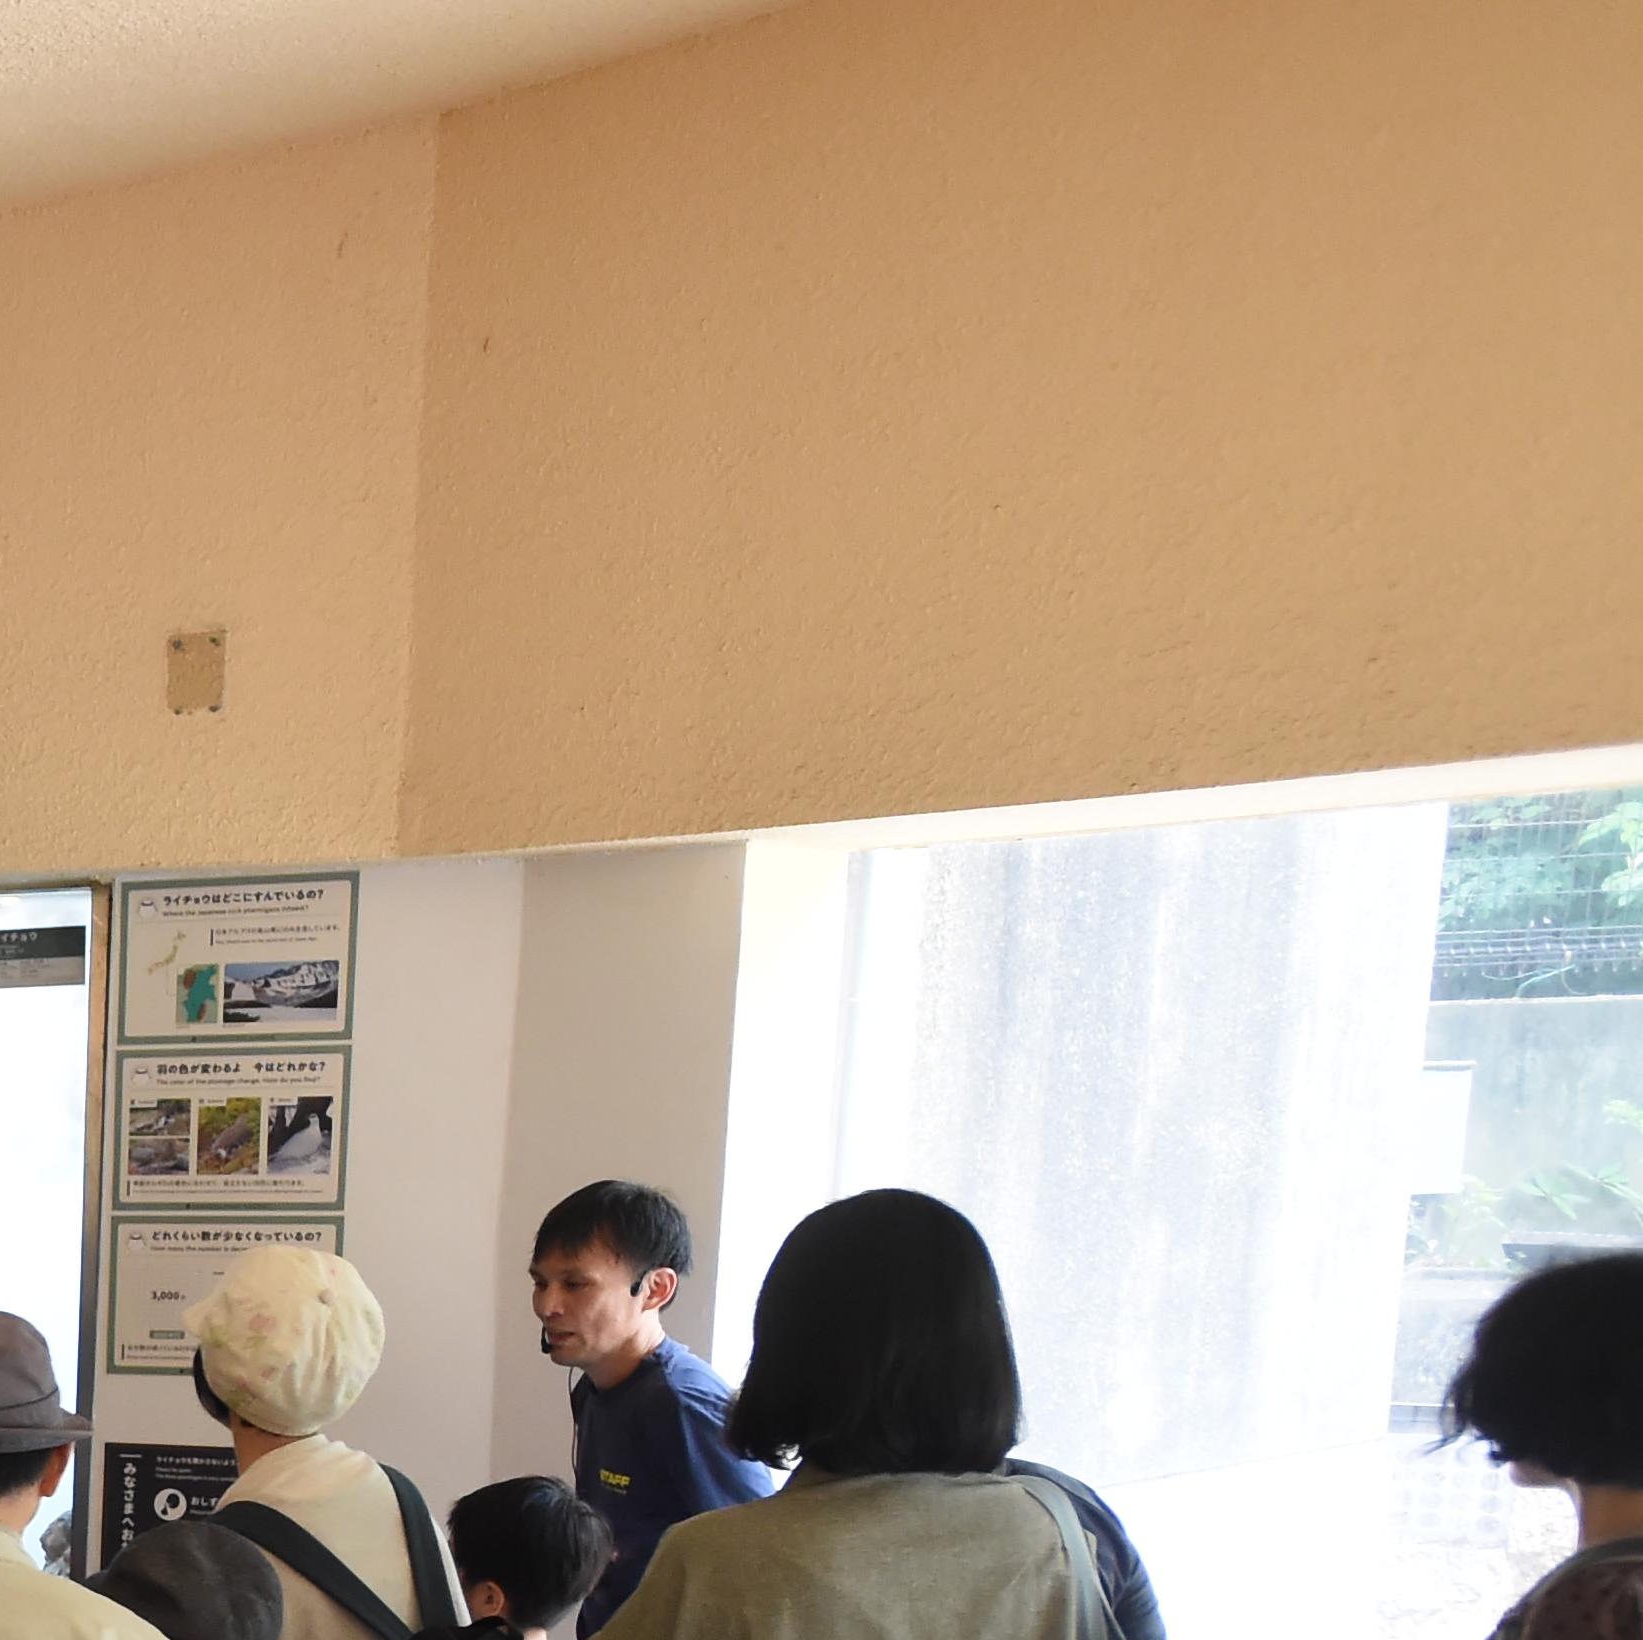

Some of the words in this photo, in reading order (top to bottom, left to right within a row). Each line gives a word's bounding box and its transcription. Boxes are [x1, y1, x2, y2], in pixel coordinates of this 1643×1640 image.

[157, 1063, 241, 1075] 羽の色が変わるよ
[254, 1060, 326, 1073] 今はどれかな?
[121, 1462, 137, 1548] みなさまへお
